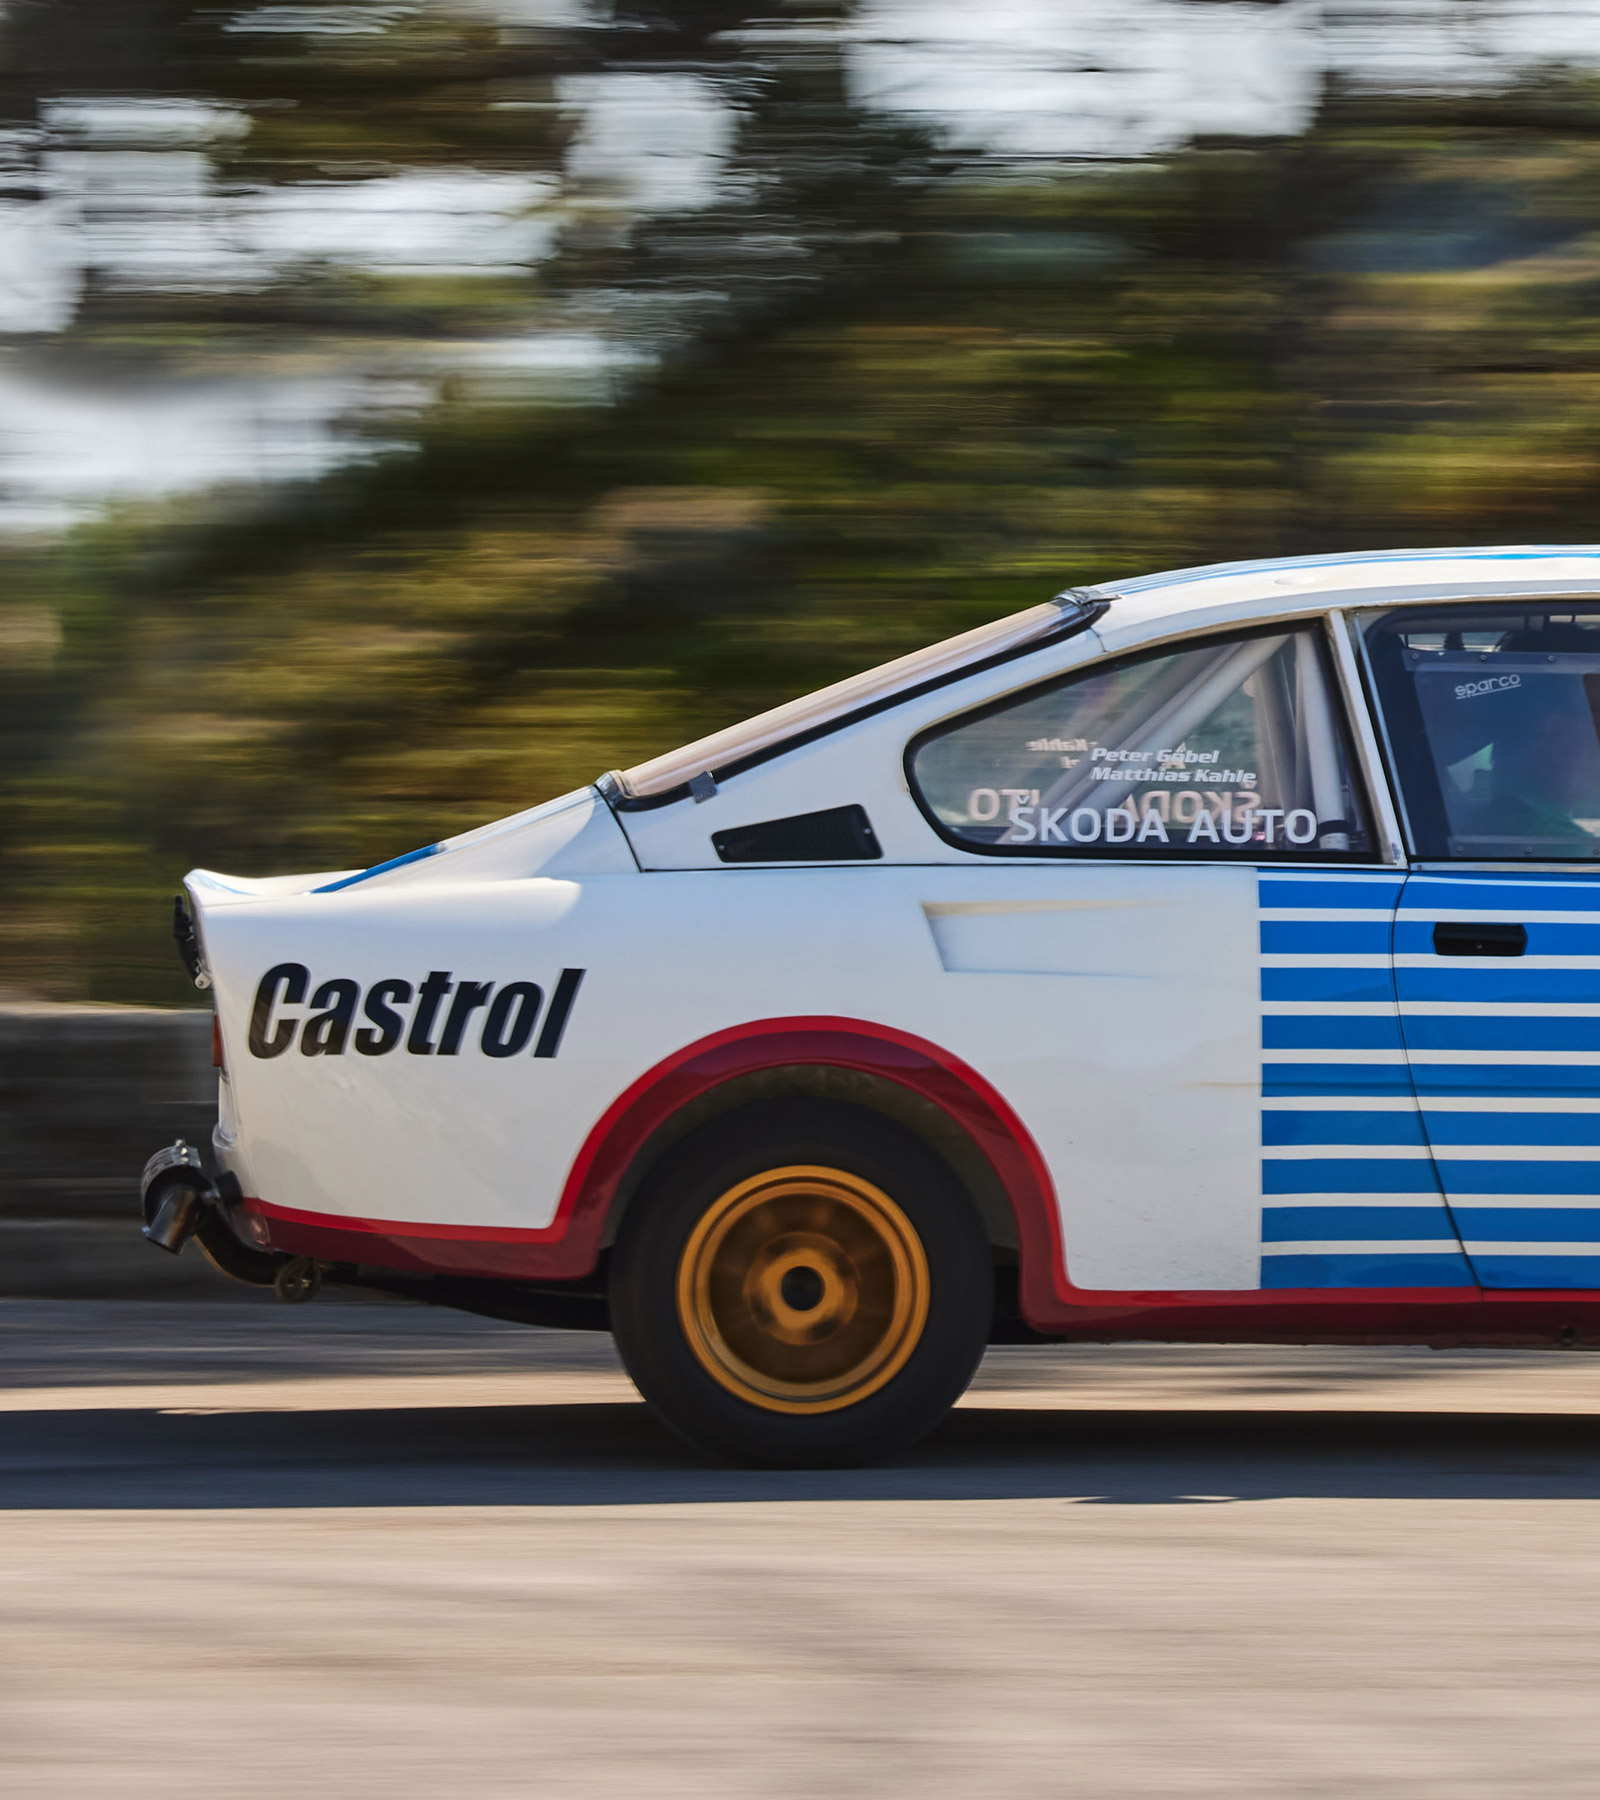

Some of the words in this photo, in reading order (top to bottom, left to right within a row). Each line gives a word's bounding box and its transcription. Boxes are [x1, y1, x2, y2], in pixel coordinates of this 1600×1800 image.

[1455, 674, 1521, 699] sparco
[1091, 748, 1150, 762] Peter
[1091, 767, 1190, 782] Matthias
[1195, 769, 1257, 783] Kahle
[1009, 796, 1170, 843] ŠKODA
[1187, 809, 1317, 844] AUTO
[249, 962, 587, 1059] Castrol
